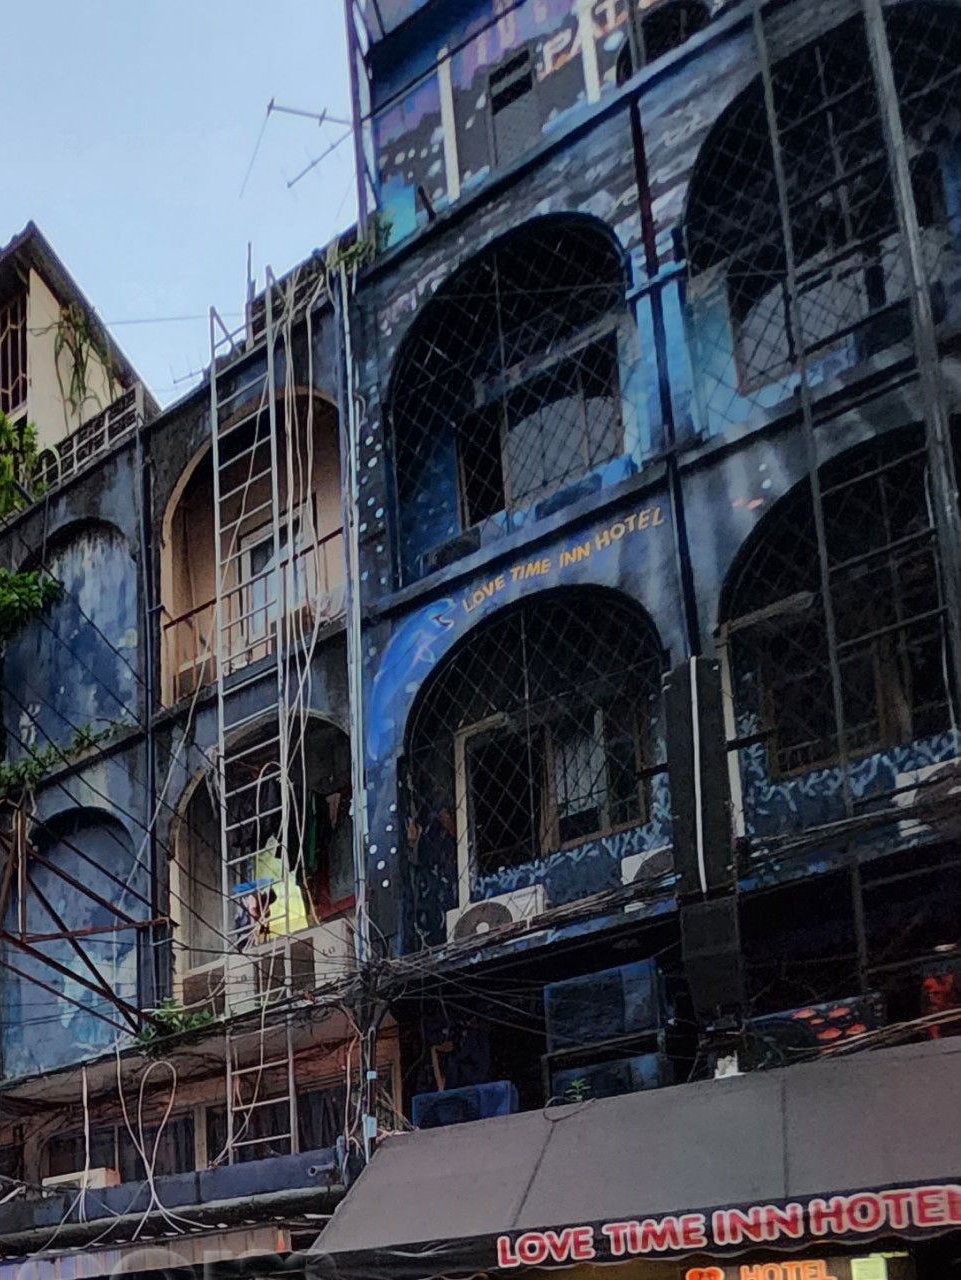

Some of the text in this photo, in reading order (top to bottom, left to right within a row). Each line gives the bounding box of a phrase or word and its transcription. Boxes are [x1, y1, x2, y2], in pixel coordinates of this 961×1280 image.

[461, 507, 665, 613] LOVE TIME INN HOTEL
[497, 1226, 595, 1269] LOVE
[603, 1213, 708, 1256] TIME
[712, 1202, 805, 1245] INN
